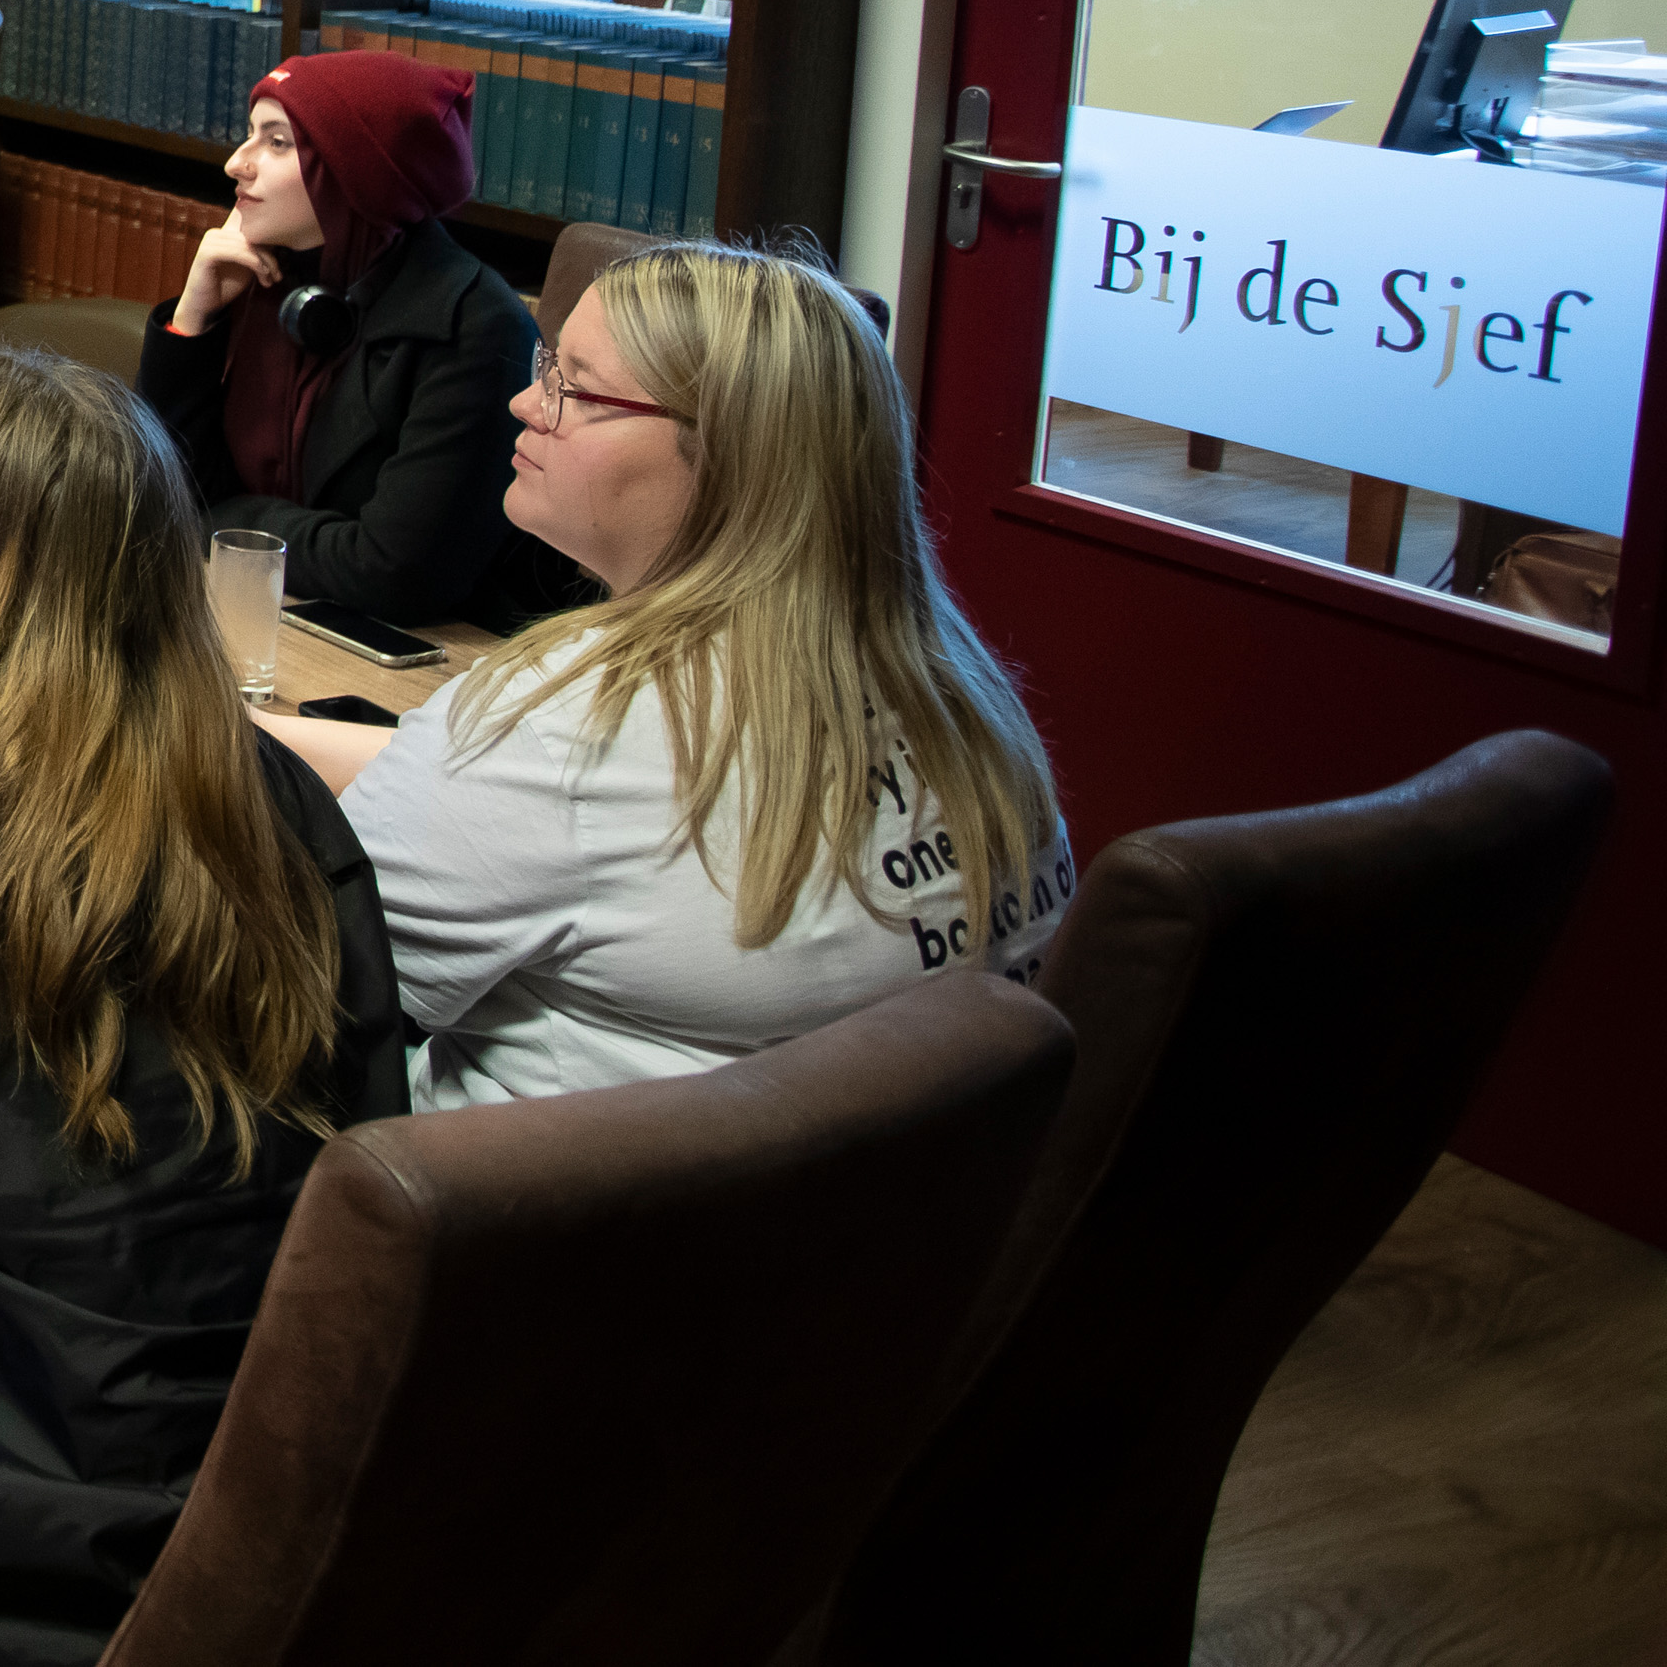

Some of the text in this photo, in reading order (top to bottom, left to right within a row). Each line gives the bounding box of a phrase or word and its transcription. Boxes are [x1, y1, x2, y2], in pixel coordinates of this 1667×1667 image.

[1093, 215, 1595, 390] Bij de Sjef
